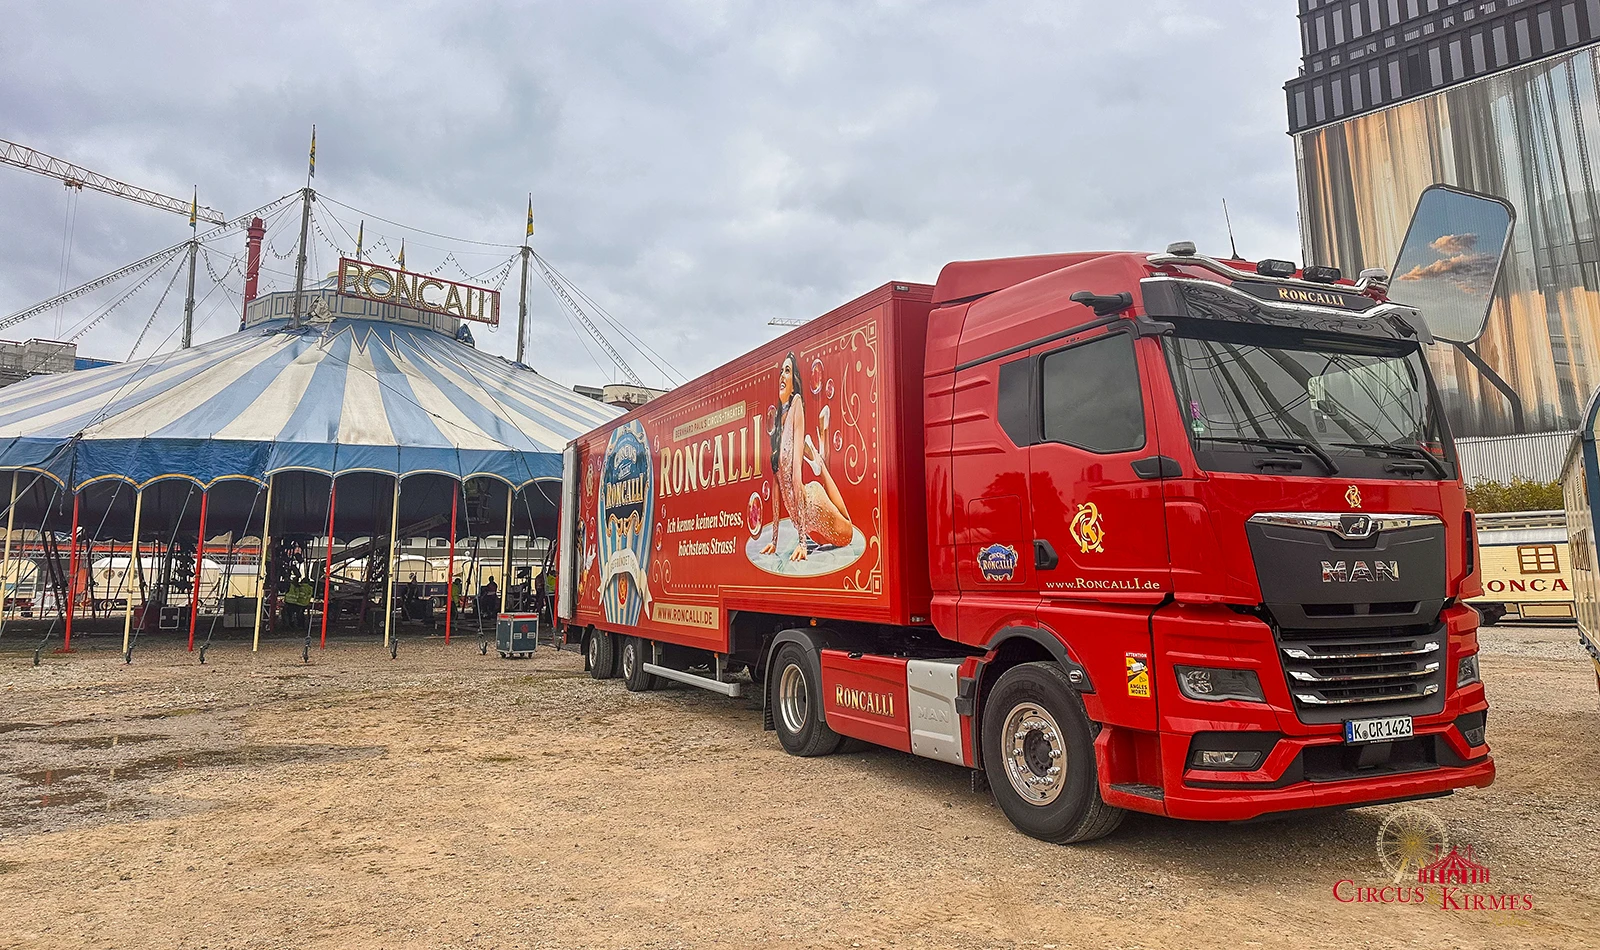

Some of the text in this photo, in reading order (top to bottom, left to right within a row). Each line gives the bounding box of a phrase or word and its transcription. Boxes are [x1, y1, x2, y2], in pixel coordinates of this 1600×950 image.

[342, 261, 498, 323] RONCALLI
[1277, 287, 1345, 306] RONCALLI
[659, 414, 762, 499] RONCALLI
[606, 473, 644, 509] RONCALLI
[666, 510, 744, 533] Ich kenne keinen Stress,
[678, 536, 737, 557] höchstens Strass!
[982, 558, 1014, 570] RONCALLI
[1320, 560, 1399, 582] MAN
[1481, 578, 1569, 593] ONCA
[657, 606, 713, 625] WWW.RONCALLI.DE
[835, 683, 895, 718] RONCALLI
[917, 705, 949, 723] MAN
[1354, 723, 1362, 739] K
[1385, 720, 1411, 735] 1423
